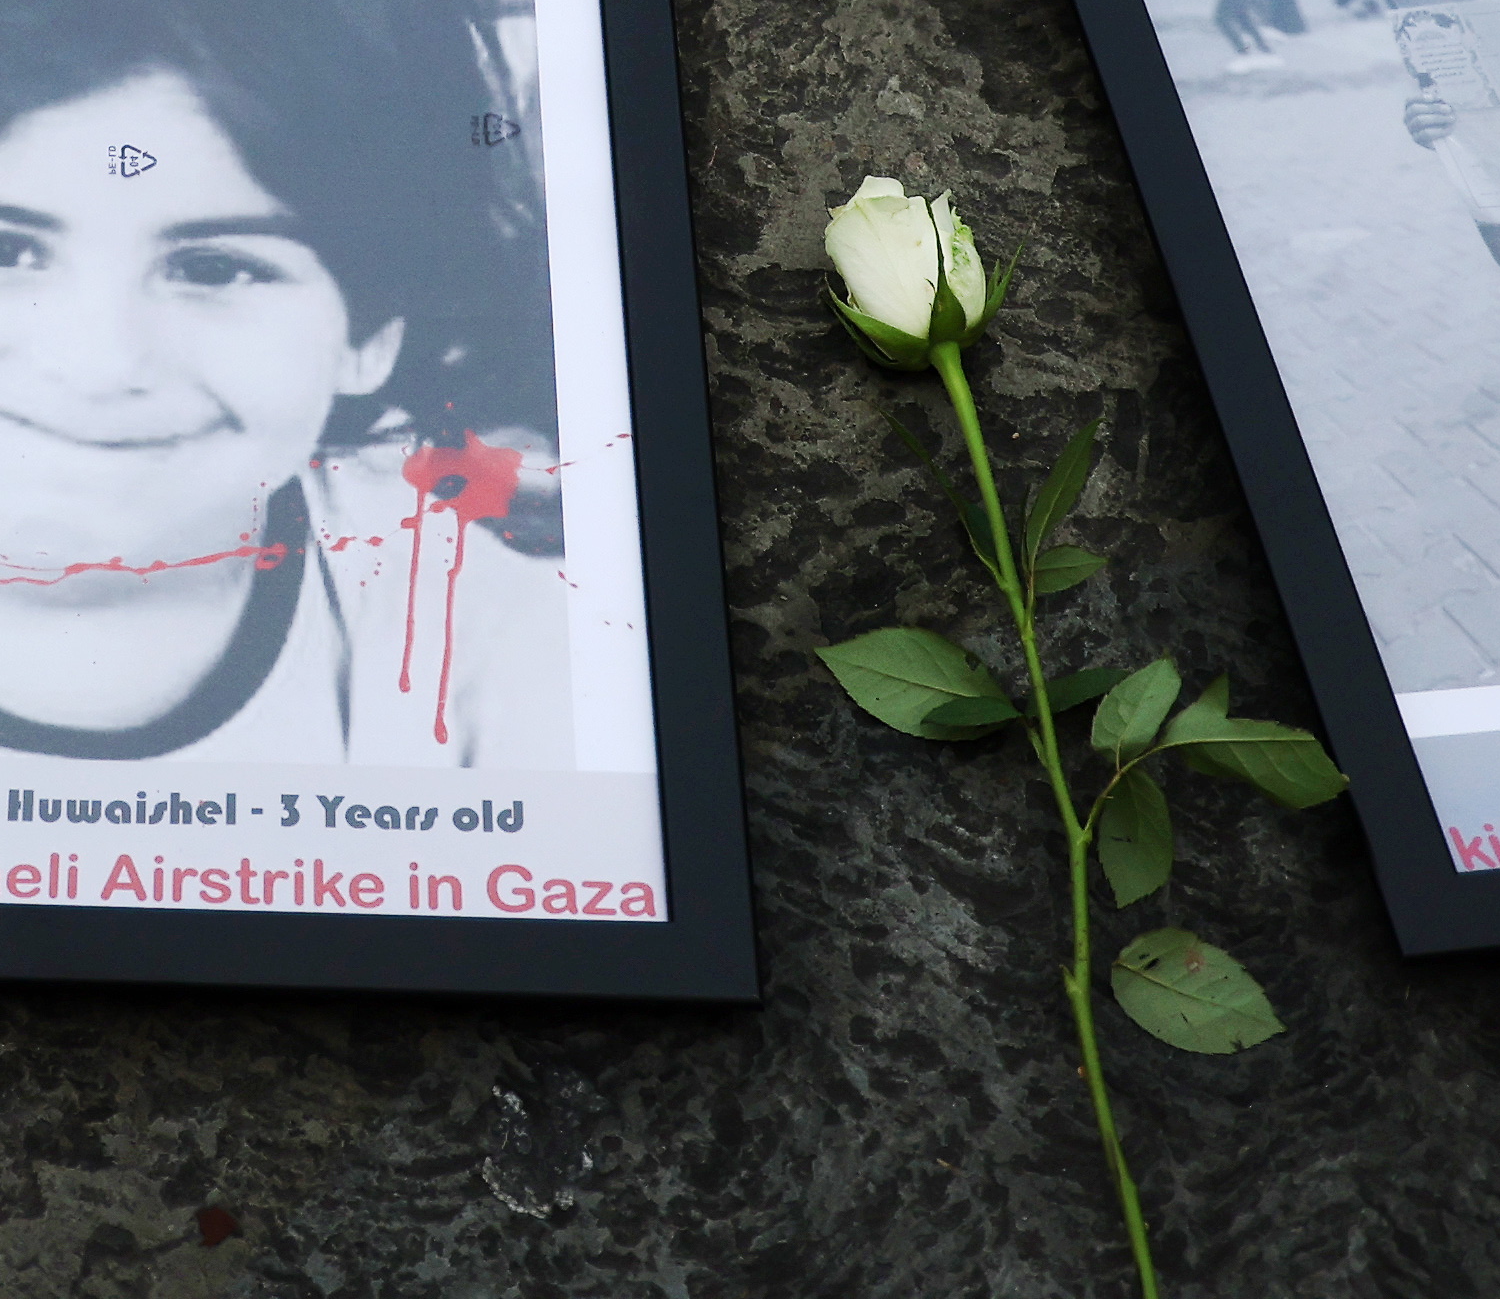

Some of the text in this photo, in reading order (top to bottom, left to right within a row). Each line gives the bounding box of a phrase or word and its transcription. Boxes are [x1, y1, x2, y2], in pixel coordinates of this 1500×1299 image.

[7, 789, 236, 825] Huwaishel
[281, 794, 300, 827] 3
[316, 795, 438, 831] Years
[452, 800, 524, 833] old
[102, 855, 385, 908] Airstrike
[410, 863, 462, 910] in
[488, 865, 656, 916] Gaza
